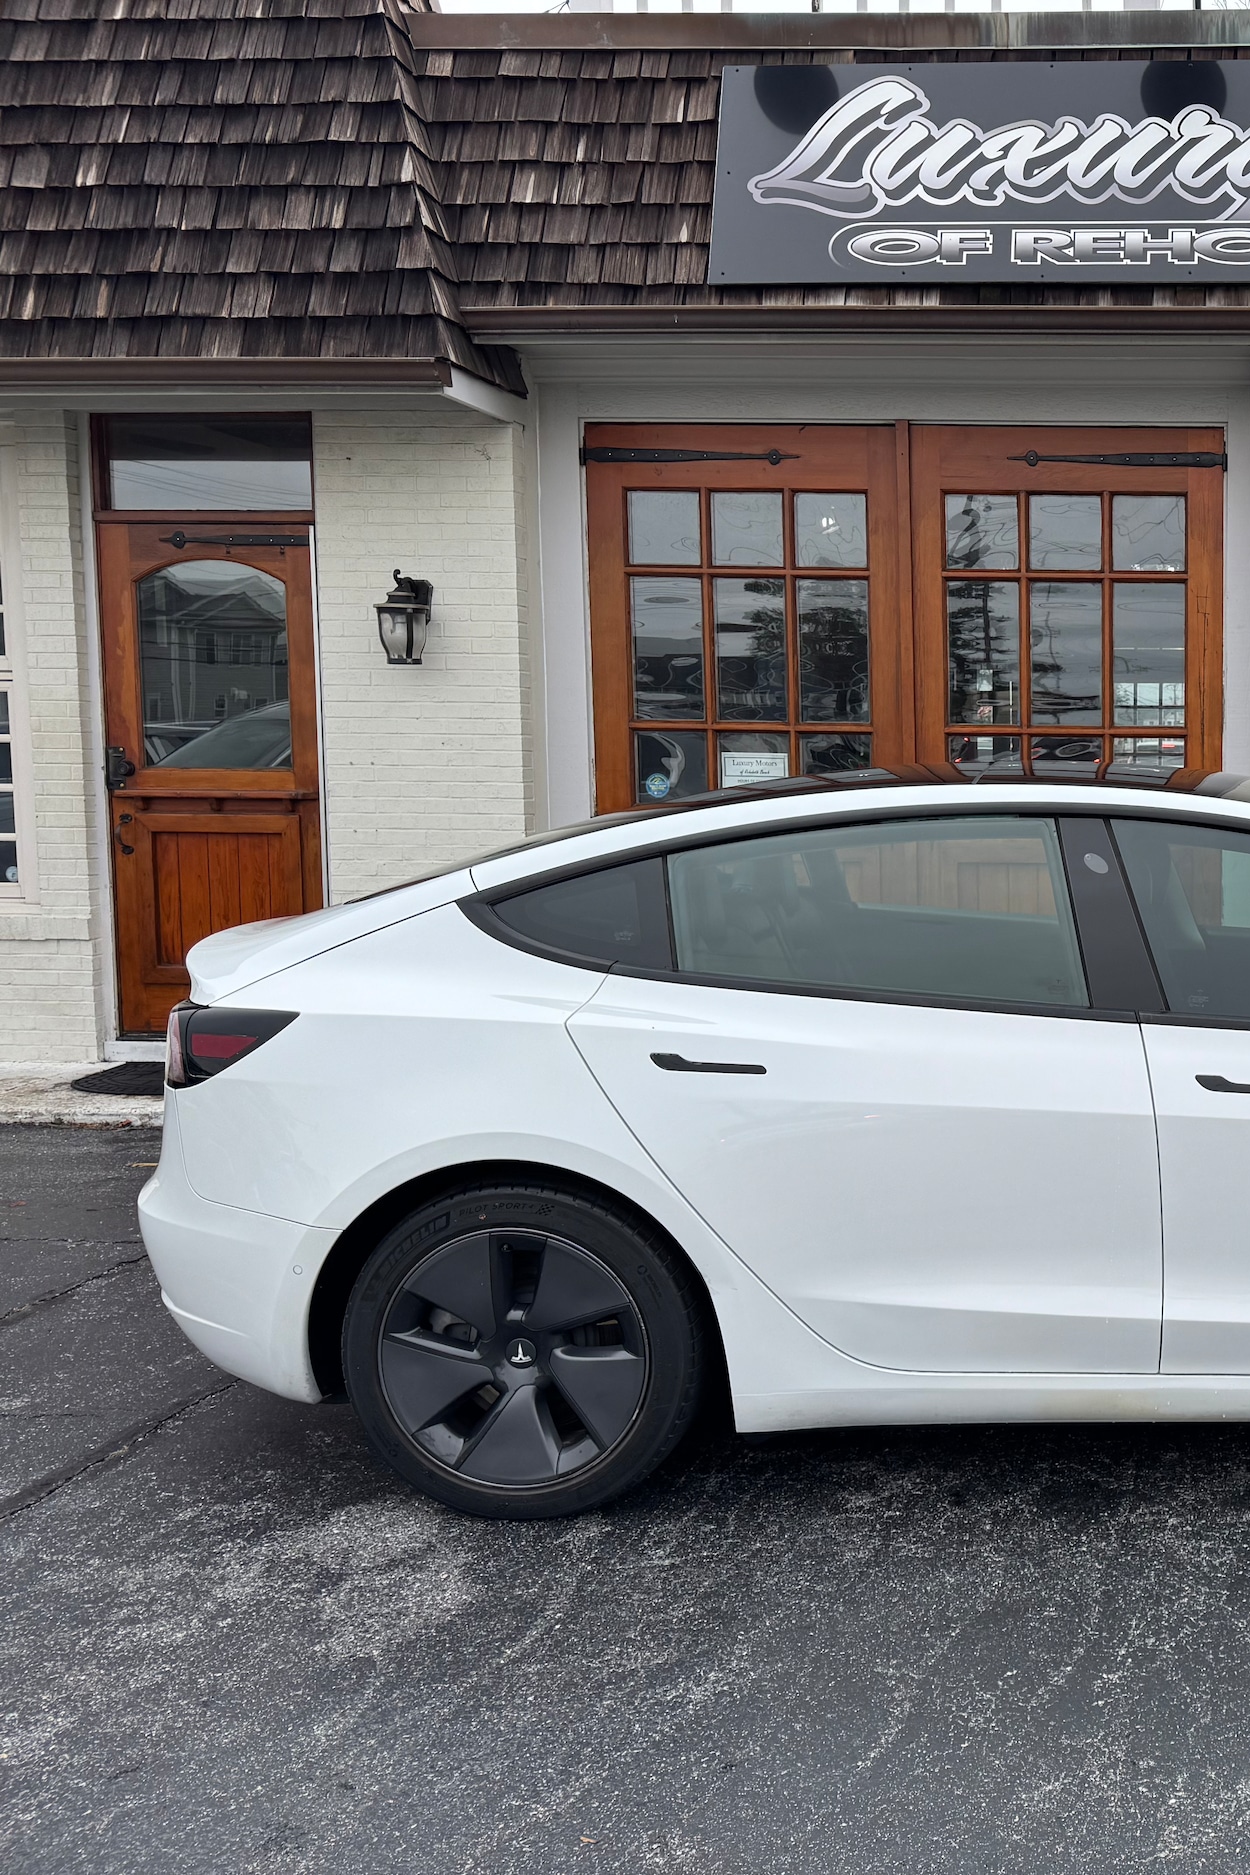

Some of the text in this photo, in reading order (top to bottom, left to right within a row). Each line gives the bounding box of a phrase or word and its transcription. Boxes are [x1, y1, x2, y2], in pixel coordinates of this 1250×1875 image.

[848, 229, 992, 265] OF
[732, 759, 754, 767] Luxury
[492, 1202, 528, 1210] SPORT
